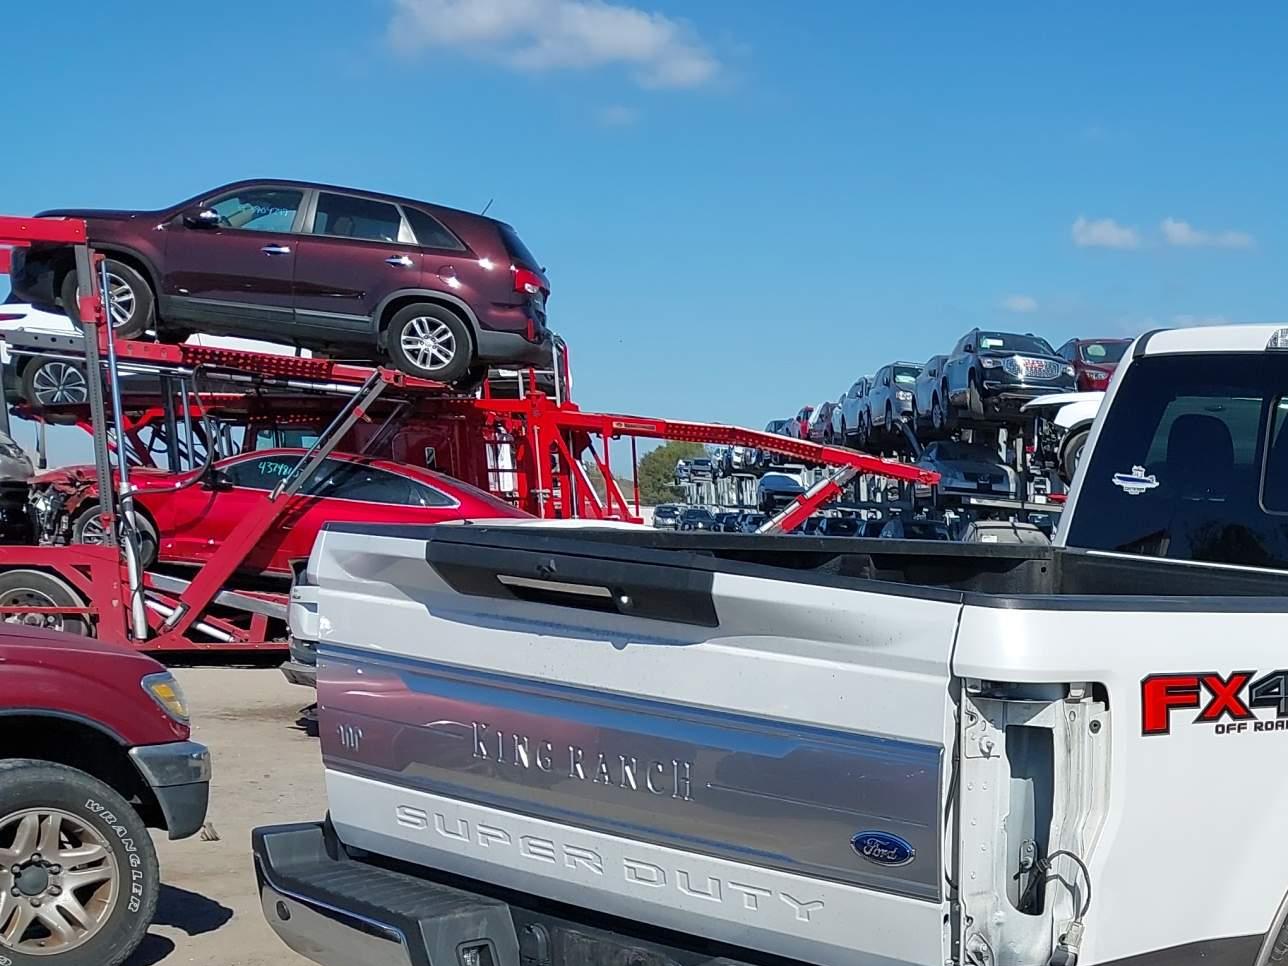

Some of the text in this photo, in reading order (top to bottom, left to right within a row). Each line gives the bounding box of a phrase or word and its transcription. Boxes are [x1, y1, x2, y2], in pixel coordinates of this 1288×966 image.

[472, 721, 695, 801] KING RANCH
[1215, 722, 1247, 735] OFF
[85, 799, 143, 913] WRANGLER
[396, 804, 826, 923] SUPER DUTY
